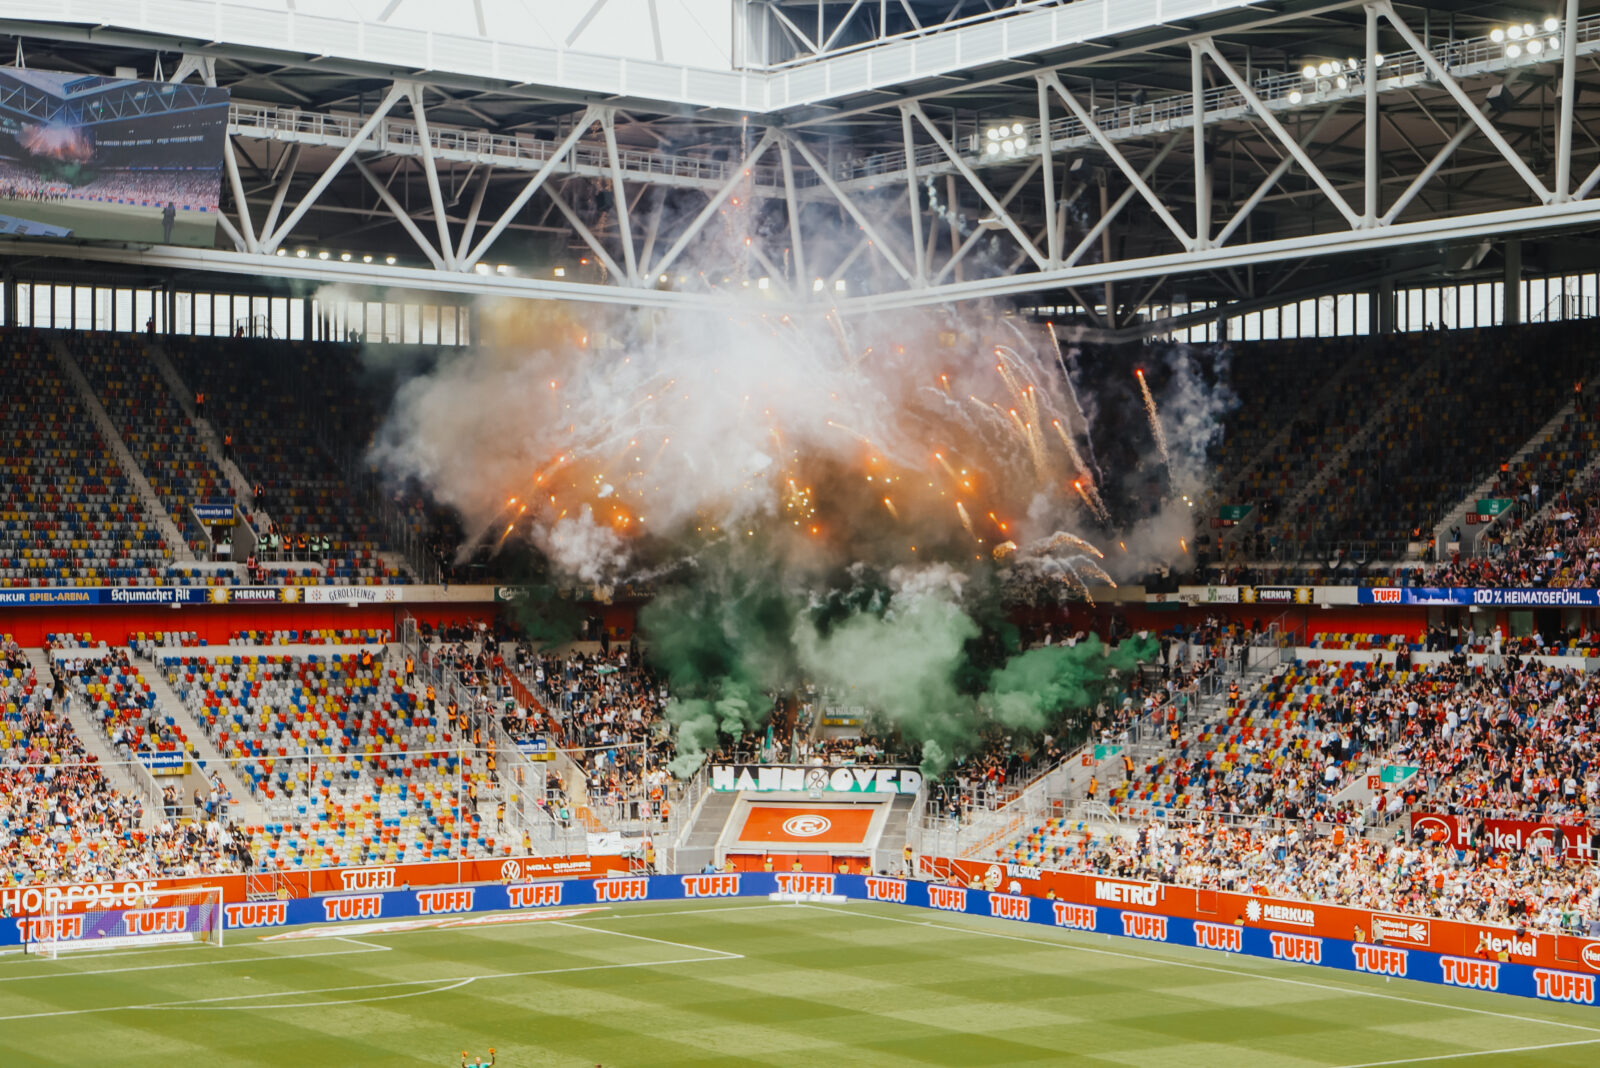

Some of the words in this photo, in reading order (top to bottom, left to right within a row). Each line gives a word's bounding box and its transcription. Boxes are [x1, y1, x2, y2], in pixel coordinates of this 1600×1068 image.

[29, 592, 90, 602] SPIEL-ARENA
[111, 588, 173, 603] Schumacher
[175, 588, 190, 602] Alt
[235, 590, 276, 599] MERKUR
[329, 588, 377, 602] GEROLSTEINER
[1260, 590, 1292, 599] MERKUR
[1372, 588, 1401, 602] TUFFI
[1473, 590, 1493, 603] 100
[1494, 591, 1502, 603] %
[1504, 588, 1592, 604] HEIMATGEFÜHL...
[1370, 777, 1380, 789] 23
[553, 861, 591, 869] GRUPPE
[341, 868, 395, 890] TUFFI
[594, 877, 649, 901] TUFFI
[682, 873, 741, 896] TUFFI
[775, 874, 836, 895] TUFFI
[866, 877, 907, 903] TUFFI
[417, 888, 475, 914] TUFFI
[507, 882, 563, 908] TUFFI
[928, 884, 967, 912] TUFFI
[1095, 880, 1157, 906] METRO
[225, 902, 288, 928] TUFFI
[324, 894, 383, 920] TUFFI
[989, 893, 1030, 921] TUFFI
[1053, 901, 1097, 930] TUFFI
[1264, 904, 1315, 923] MERKUR
[17, 914, 84, 943] TUFFI
[123, 907, 189, 935] TUFFI
[1121, 912, 1168, 941] TUFFI
[1193, 921, 1243, 952] TUFFI
[1270, 932, 1322, 964] TUFFI
[1479, 931, 1537, 957] Henkel
[1352, 943, 1408, 977] TUFFI
[1440, 956, 1500, 990] TUFFI
[1533, 968, 1595, 1003] TUFFI
